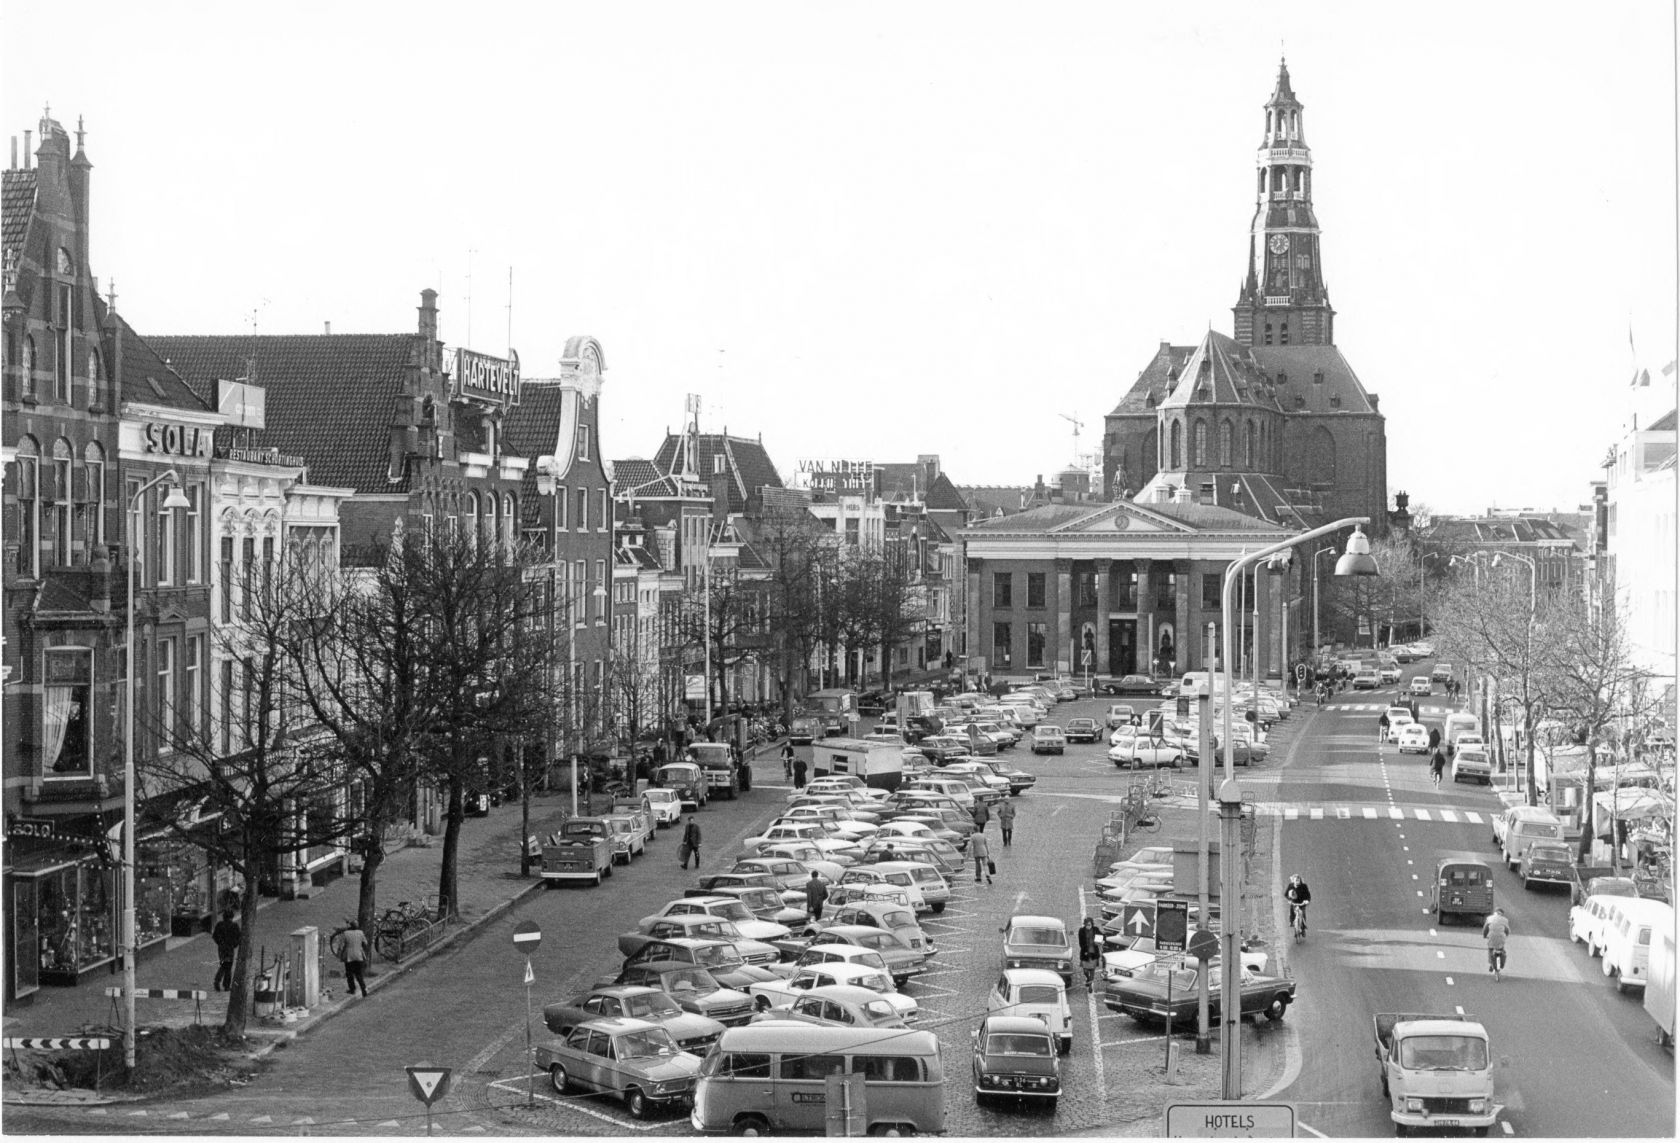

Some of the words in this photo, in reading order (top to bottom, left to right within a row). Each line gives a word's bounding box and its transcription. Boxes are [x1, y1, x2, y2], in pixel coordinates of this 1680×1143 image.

[463, 355, 519, 396] HARTEVELT
[229, 448, 264, 464] RESTAURANT
[799, 460, 824, 473] VAN
[1205, 1114, 1255, 1129] HOTELS
